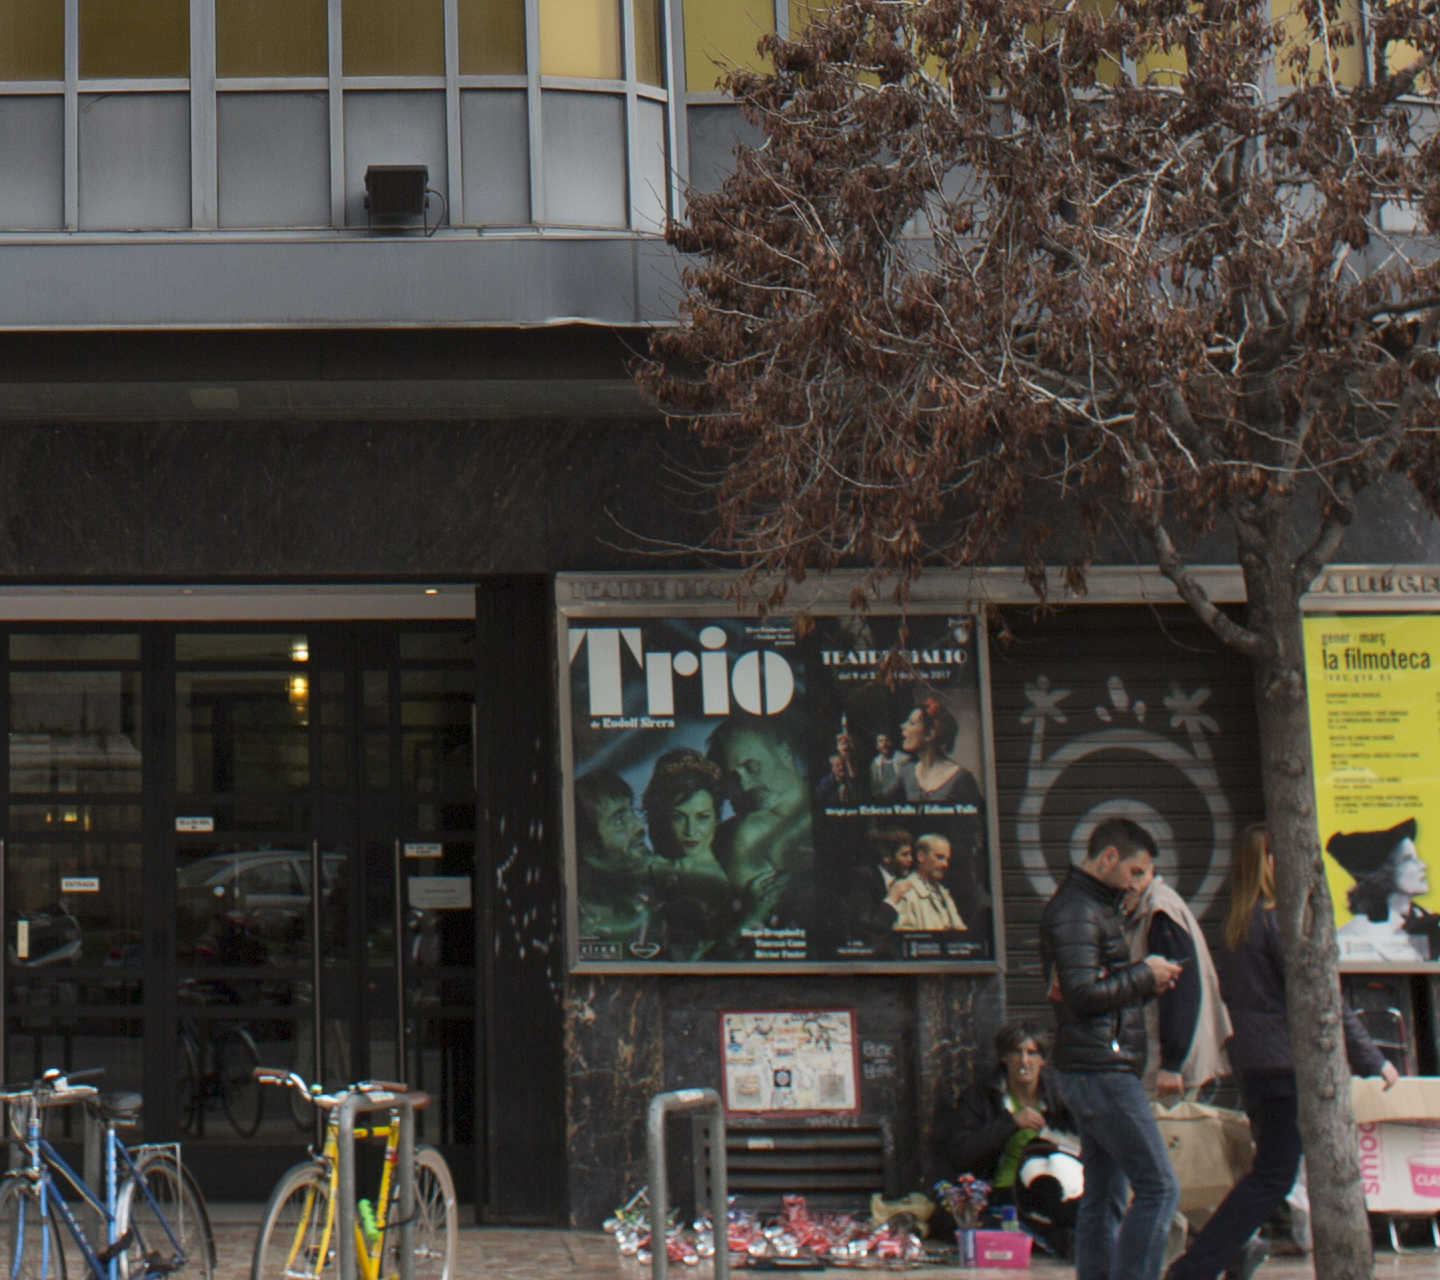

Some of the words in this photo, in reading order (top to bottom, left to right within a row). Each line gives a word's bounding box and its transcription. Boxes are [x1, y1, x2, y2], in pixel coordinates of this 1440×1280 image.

[568, 625, 795, 717] Trio
[1322, 649, 1338, 669] la
[1345, 648, 1431, 669] filmoteca
